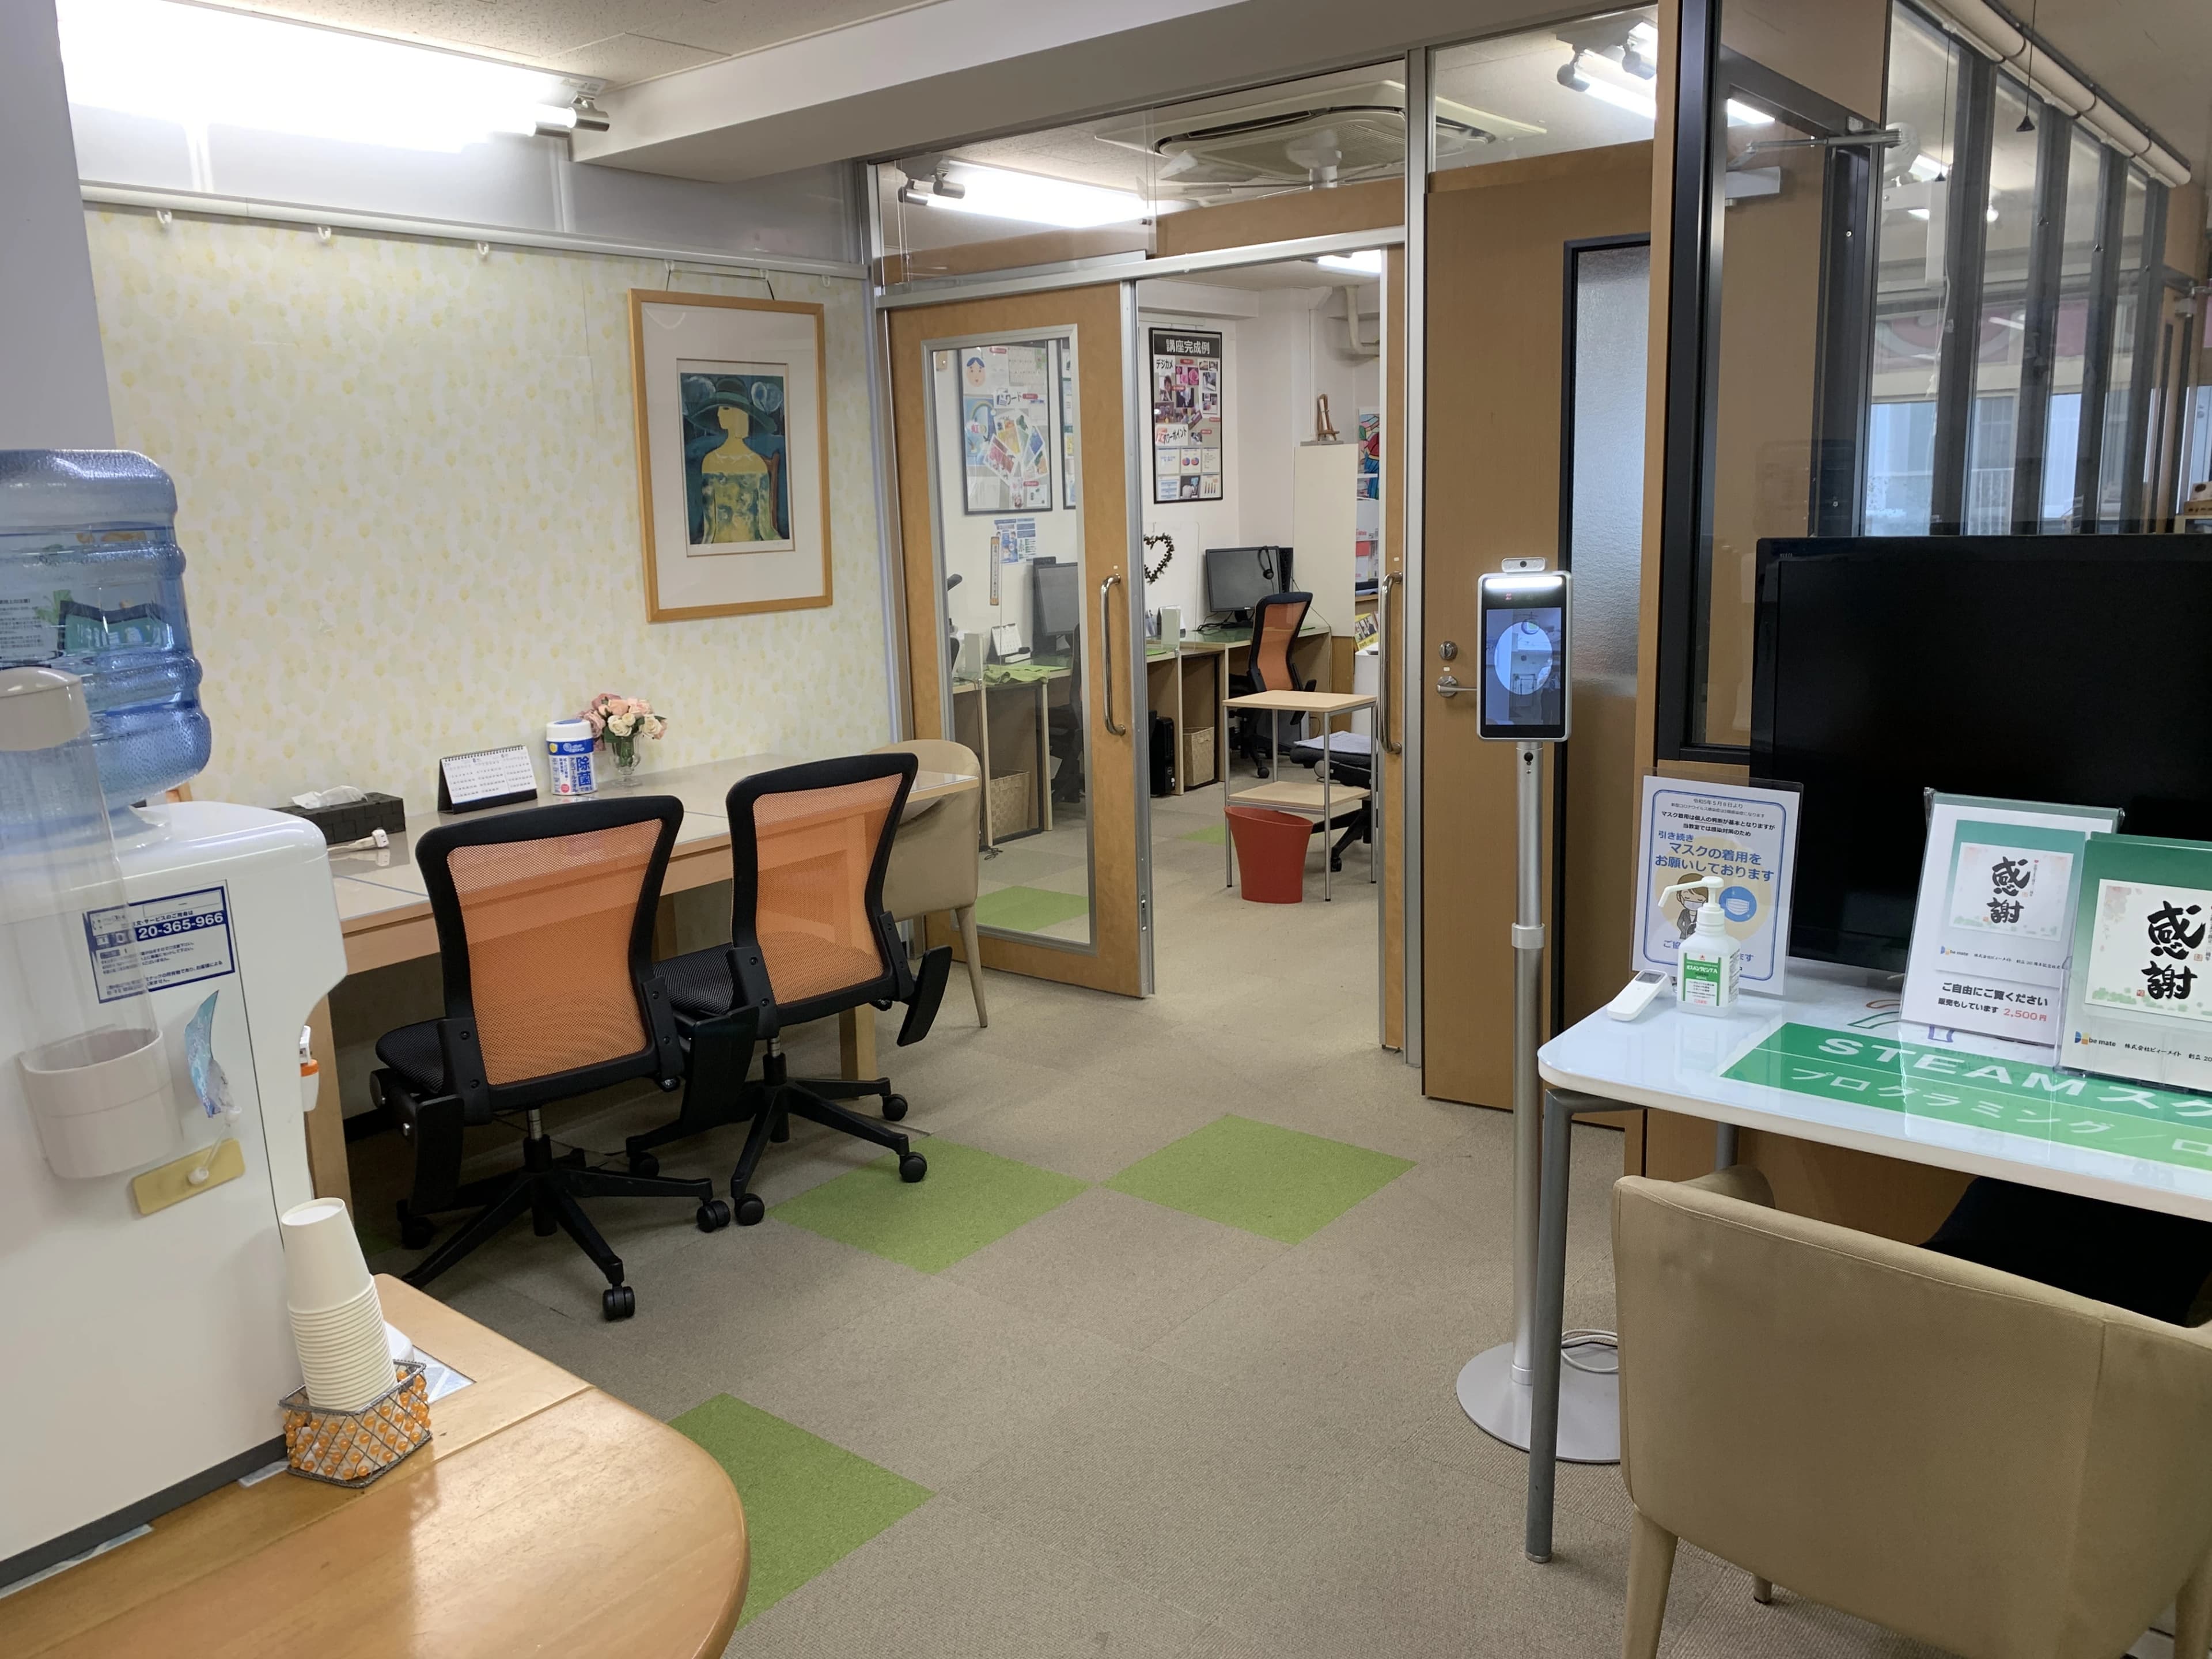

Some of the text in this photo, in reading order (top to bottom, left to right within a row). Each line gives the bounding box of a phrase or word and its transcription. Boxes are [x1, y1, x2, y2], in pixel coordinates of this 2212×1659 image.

[1165, 339, 1210, 355] 講座完成例
[1156, 359, 1173, 370] デジカメ
[576, 756, 592, 787] 除菌
[1661, 810, 1775, 830] マスク着用は個人の判断が基本となりますが
[1658, 830, 1694, 842] 引き続き
[1683, 823, 1751, 837] 当教室では感染対策のため
[1669, 842, 1762, 866] マスクの着用を
[1655, 855, 1774, 881] お願いしております
[1942, 982, 2048, 1006] ご自由にご覧ください
[1938, 997, 1999, 1013] 販売もしています
[2124, 1043, 2181, 1057] 株式会社ビィーメイト
